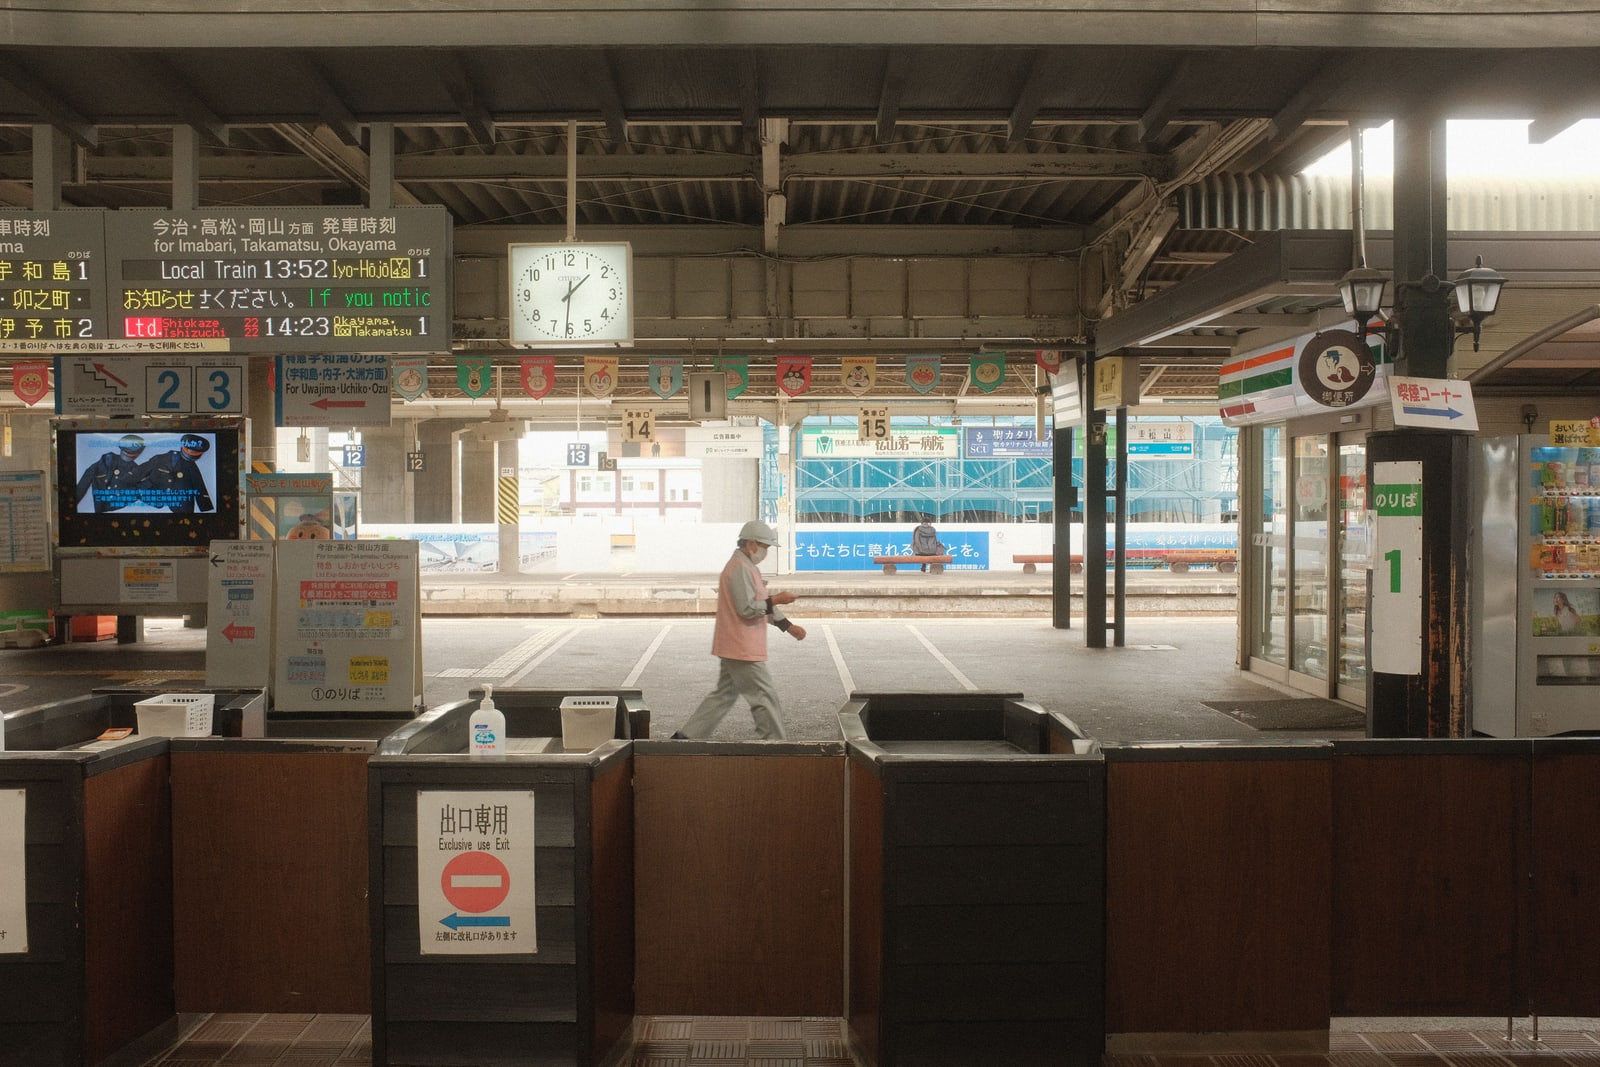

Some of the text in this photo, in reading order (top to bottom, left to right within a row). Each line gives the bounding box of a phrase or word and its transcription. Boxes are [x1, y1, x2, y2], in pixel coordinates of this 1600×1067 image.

[289, 222, 314, 236] 方面
[322, 216, 396, 235] 発車時刻
[154, 237, 397, 255] for Imabari, Takamatsu, Okayama
[407, 248, 430, 256] のりば
[67, 251, 91, 259] のりば
[563, 253, 576, 267] 12
[78, 261, 89, 280] 1
[161, 260, 205, 280] Local
[214, 260, 257, 279] Train
[264, 259, 329, 279] 13:52
[417, 259, 427, 278] 1
[546, 257, 555, 271] 11
[529, 266, 609, 282] 10 2
[124, 288, 195, 310] お知らせ
[310, 288, 331, 308] If
[345, 292, 373, 308] you
[383, 288, 430, 308] notic
[523, 288, 617, 302] 9 3
[532, 307, 609, 322] 8 4
[78, 318, 93, 338] 2
[125, 318, 163, 338] Ltd.
[162, 318, 220, 328] Shiokaze
[244, 318, 259, 328] 22
[265, 317, 330, 337] 14:23
[418, 317, 428, 336] 1
[163, 327, 226, 338] Ishizuchi
[244, 327, 259, 338] 22
[352, 325, 412, 337] Takamatsu
[550, 319, 592, 332] 7 5
[567, 322, 574, 335] 6
[157, 370, 231, 410] 2 3
[286, 383, 299, 394] For
[626, 420, 651, 439] 14
[862, 419, 887, 438] 15
[350, 452, 361, 465] 12
[410, 459, 423, 470] 12
[569, 450, 586, 464] 13
[1375, 492, 1418, 508] のりば
[1384, 550, 1401, 593] 1
[440, 803, 508, 836] 出口専用
[439, 837, 510, 851] Exclusive use Exit
[435, 930, 518, 942] 左側に改札口があります
